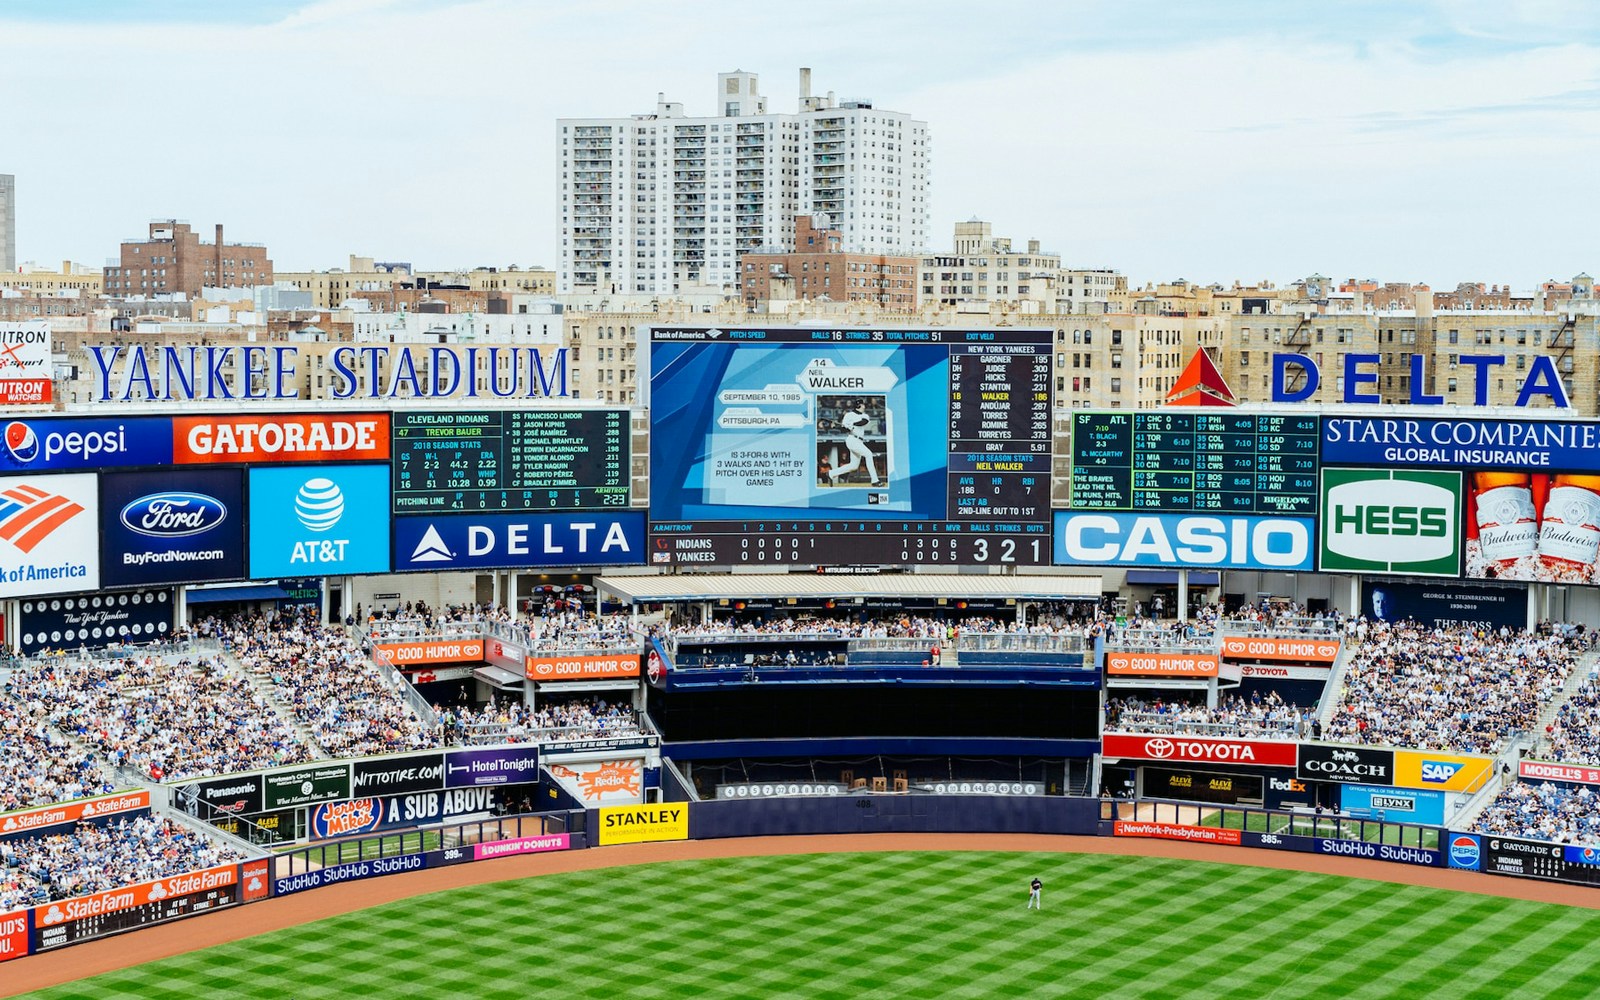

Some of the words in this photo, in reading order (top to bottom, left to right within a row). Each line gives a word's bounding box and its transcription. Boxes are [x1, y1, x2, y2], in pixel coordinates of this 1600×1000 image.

[84, 346, 298, 400] YANKEE
[329, 347, 569, 397] STADIUM
[1272, 352, 1572, 408] DELTA
[809, 377, 864, 387] WALKER
[407, 415, 453, 424] CLEVELAND
[456, 415, 489, 423] INDIANS
[45, 425, 127, 461] pepsi
[188, 421, 378, 454] GATORADE
[1327, 420, 1426, 444] STARR
[1431, 422, 1600, 449] COMPANIE
[1385, 448, 1450, 462] GLOBAL
[1455, 451, 1549, 465] INSURANCE
[397, 497, 428, 506] PITCHING
[604, 495, 625, 504] 2:23
[141, 499, 204, 529] Ford
[1335, 505, 1447, 537] HESS
[468, 522, 630, 556] DELTA
[676, 539, 712, 548] INDIANS
[1065, 516, 1308, 567] CASIO
[1484, 530, 1538, 546] Budweiser
[1543, 527, 1598, 547] Budweiser
[123, 549, 224, 565] BuyFordNow.com
[290, 540, 349, 563] AT&T
[676, 552, 716, 562] YANKEES
[10, 566, 24, 581] of
[27, 562, 86, 581] America
[397, 646, 423, 660] GOOD
[426, 645, 461, 658] HUMOR
[1249, 642, 1275, 654] GOOD
[1278, 644, 1315, 657] HUMOR
[556, 662, 582, 674] GOOD
[584, 660, 618, 673] HUMOR
[1131, 658, 1158, 670] GOOD
[1160, 659, 1195, 672] HUMOR
[1254, 667, 1288, 676] TOYOTA
[1177, 742, 1254, 760] TOYOTA
[354, 764, 443, 787] NITTOTIRE.COM
[1305, 760, 1386, 776] COACH
[1422, 764, 1455, 780] SAP
[1525, 764, 1582, 779] MODELL'S
[206, 783, 256, 798] Panasonic
[1270, 778, 1306, 792] FedEx
[18, 810, 65, 828] StateFarm
[96, 796, 140, 813] StateFarm
[322, 798, 373, 819] Jersey
[388, 798, 400, 823] A
[405, 793, 439, 820] SUB
[443, 787, 495, 815] ABOVE
[327, 813, 374, 836] Mike's
[606, 810, 680, 827] STANLEY
[606, 829, 648, 837] PERFORMANCE
[1124, 824, 1216, 840] NewYork-Presbyterian
[1261, 835, 1277, 844] 385
[488, 842, 522, 854] DUNKIN'
[524, 838, 562, 849] DONUTS
[1323, 840, 1375, 856] StubHub
[1381, 846, 1432, 863] StubHub
[1503, 843, 1548, 854] GATORADE
[444, 850, 459, 859] 399
[278, 873, 320, 893] StubHub
[324, 864, 368, 882] StubHub
[373, 856, 420, 873] StubHub
[65, 893, 134, 920] StateFarm
[168, 870, 231, 896] StateFarm
